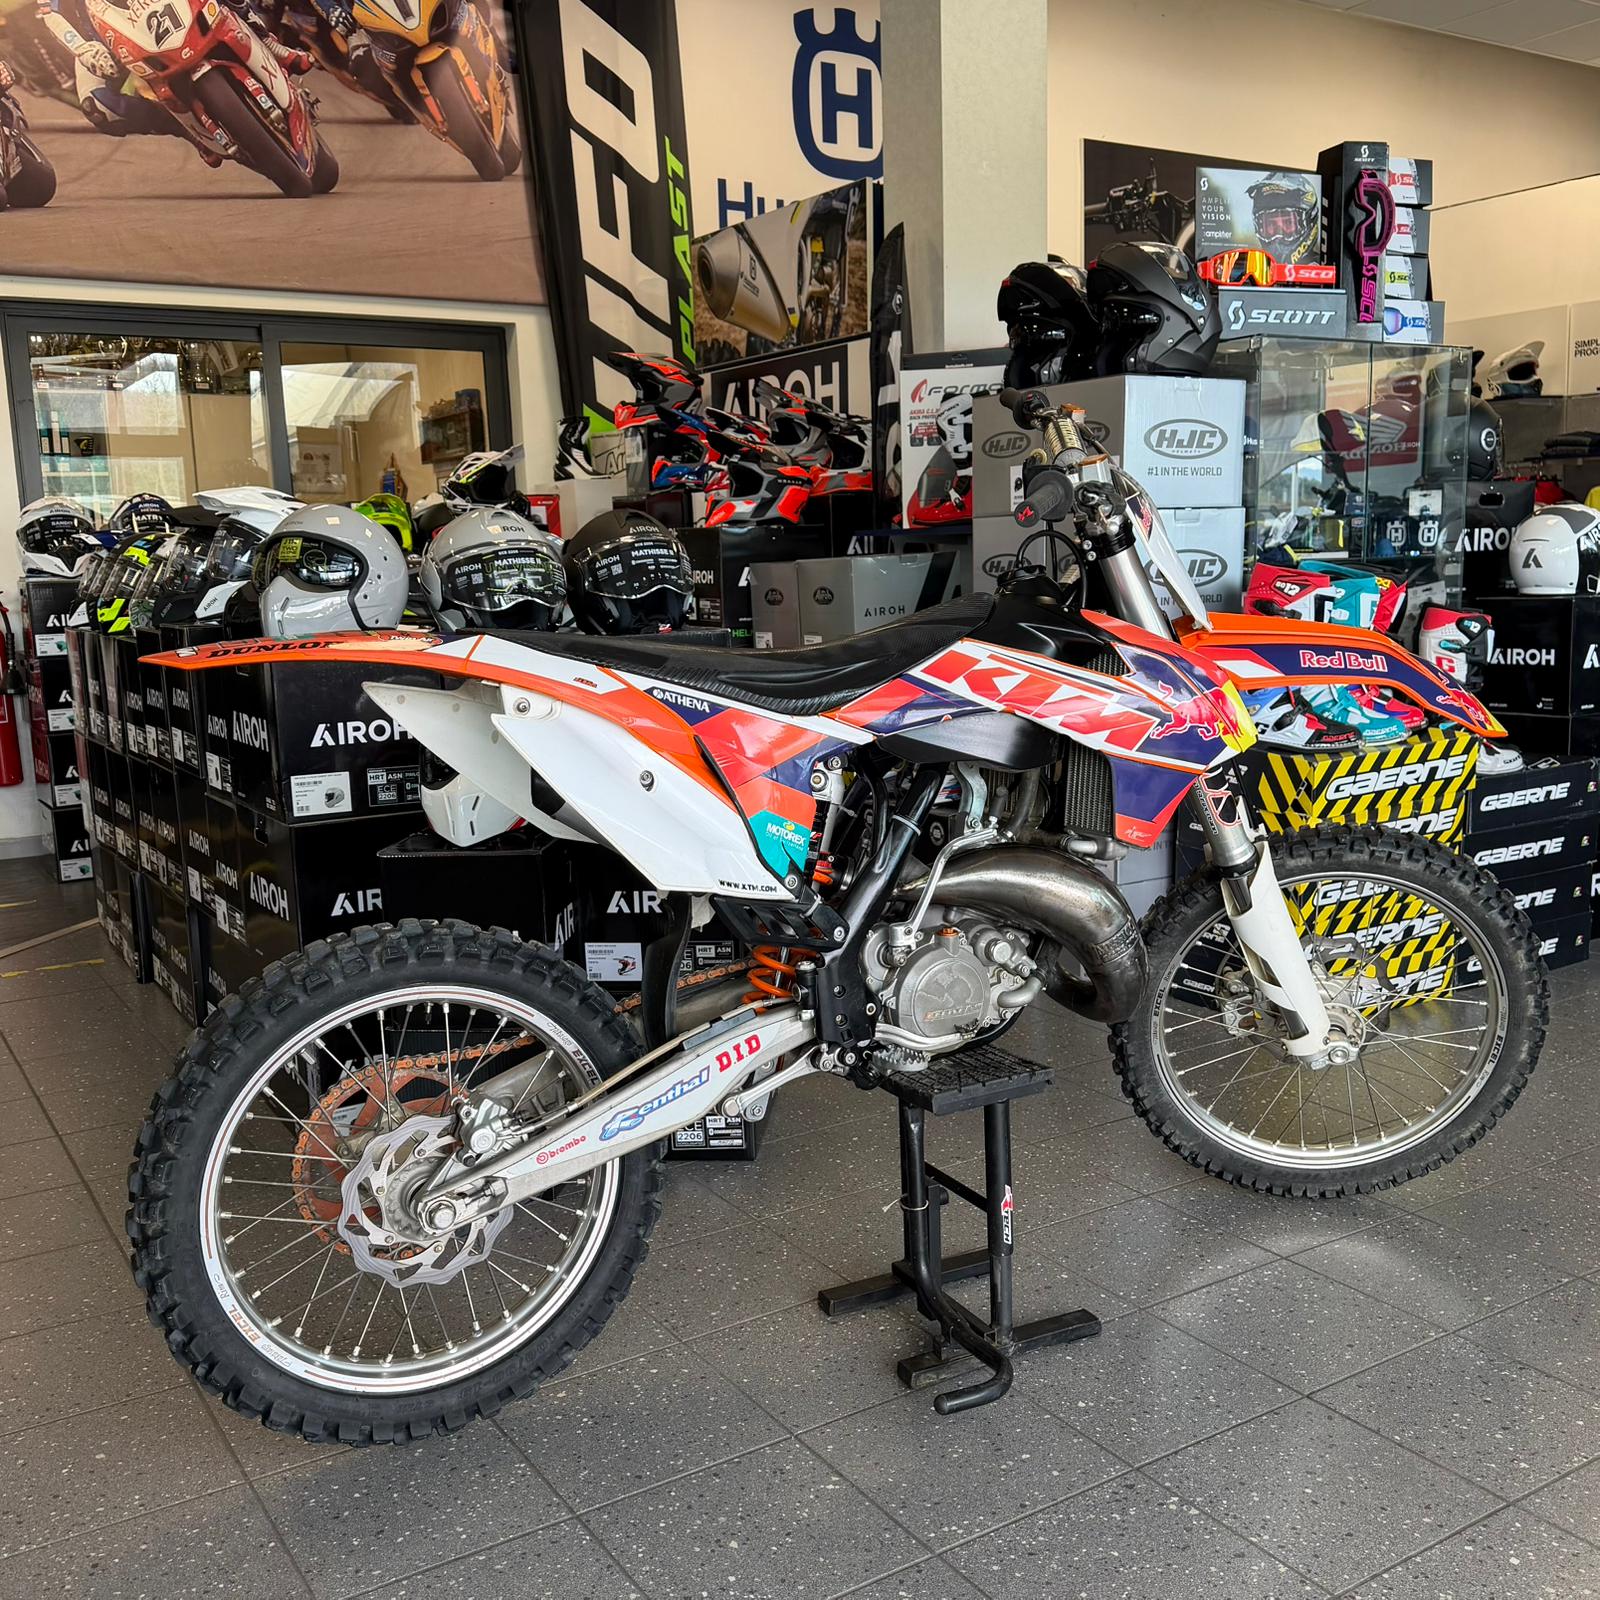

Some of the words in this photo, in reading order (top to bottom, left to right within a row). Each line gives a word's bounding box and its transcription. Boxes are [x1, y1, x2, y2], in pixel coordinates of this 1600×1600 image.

[147, 3, 185, 47] 21
[1202, 213, 1232, 221] VISION
[1247, 309, 1336, 325] SCOTT
[988, 436, 1026, 453] HJC
[1154, 429, 1218, 449] HJC
[1147, 467, 1159, 477] #1
[1160, 467, 1170, 477] IN
[1171, 467, 1189, 477] THE
[1189, 467, 1223, 477] WORLD
[629, 525, 660, 534] AIROH
[494, 557, 535, 567] MATHISSE
[595, 554, 620, 568] AIROH
[631, 548, 668, 557] MATHISSE
[455, 563, 482, 575] AIROH
[988, 559, 1018, 573] HJ
[203, 597, 218, 612] AIROH
[864, 605, 905, 617] AIROH
[1300, 650, 1344, 669] Red
[1346, 653, 1388, 673] Bull
[1490, 648, 1556, 666] AIROH
[662, 691, 711, 714] ATHENA
[920, 649, 1158, 751] KTM
[233, 710, 270, 752] AIROH
[377, 784, 398, 793] ECE
[1326, 755, 1468, 801] GAERNE
[1480, 781, 1571, 812] GAERNE
[766, 822, 807, 847] MOTOREX
[1474, 836, 1566, 867] GAERNE
[215, 859, 239, 891] AIROH
[250, 871, 290, 921] AIROH
[331, 888, 383, 917] AIR
[606, 890, 662, 914] AIR
[1153, 986, 1166, 1017] EXCEL
[1488, 1034, 1503, 1065] EXCEL
[570, 1048, 602, 1086] EXCEL
[598, 1064, 711, 1143] Renthal
[678, 1132, 702, 1140] 2206
[227, 1303, 261, 1345] EXCEL
